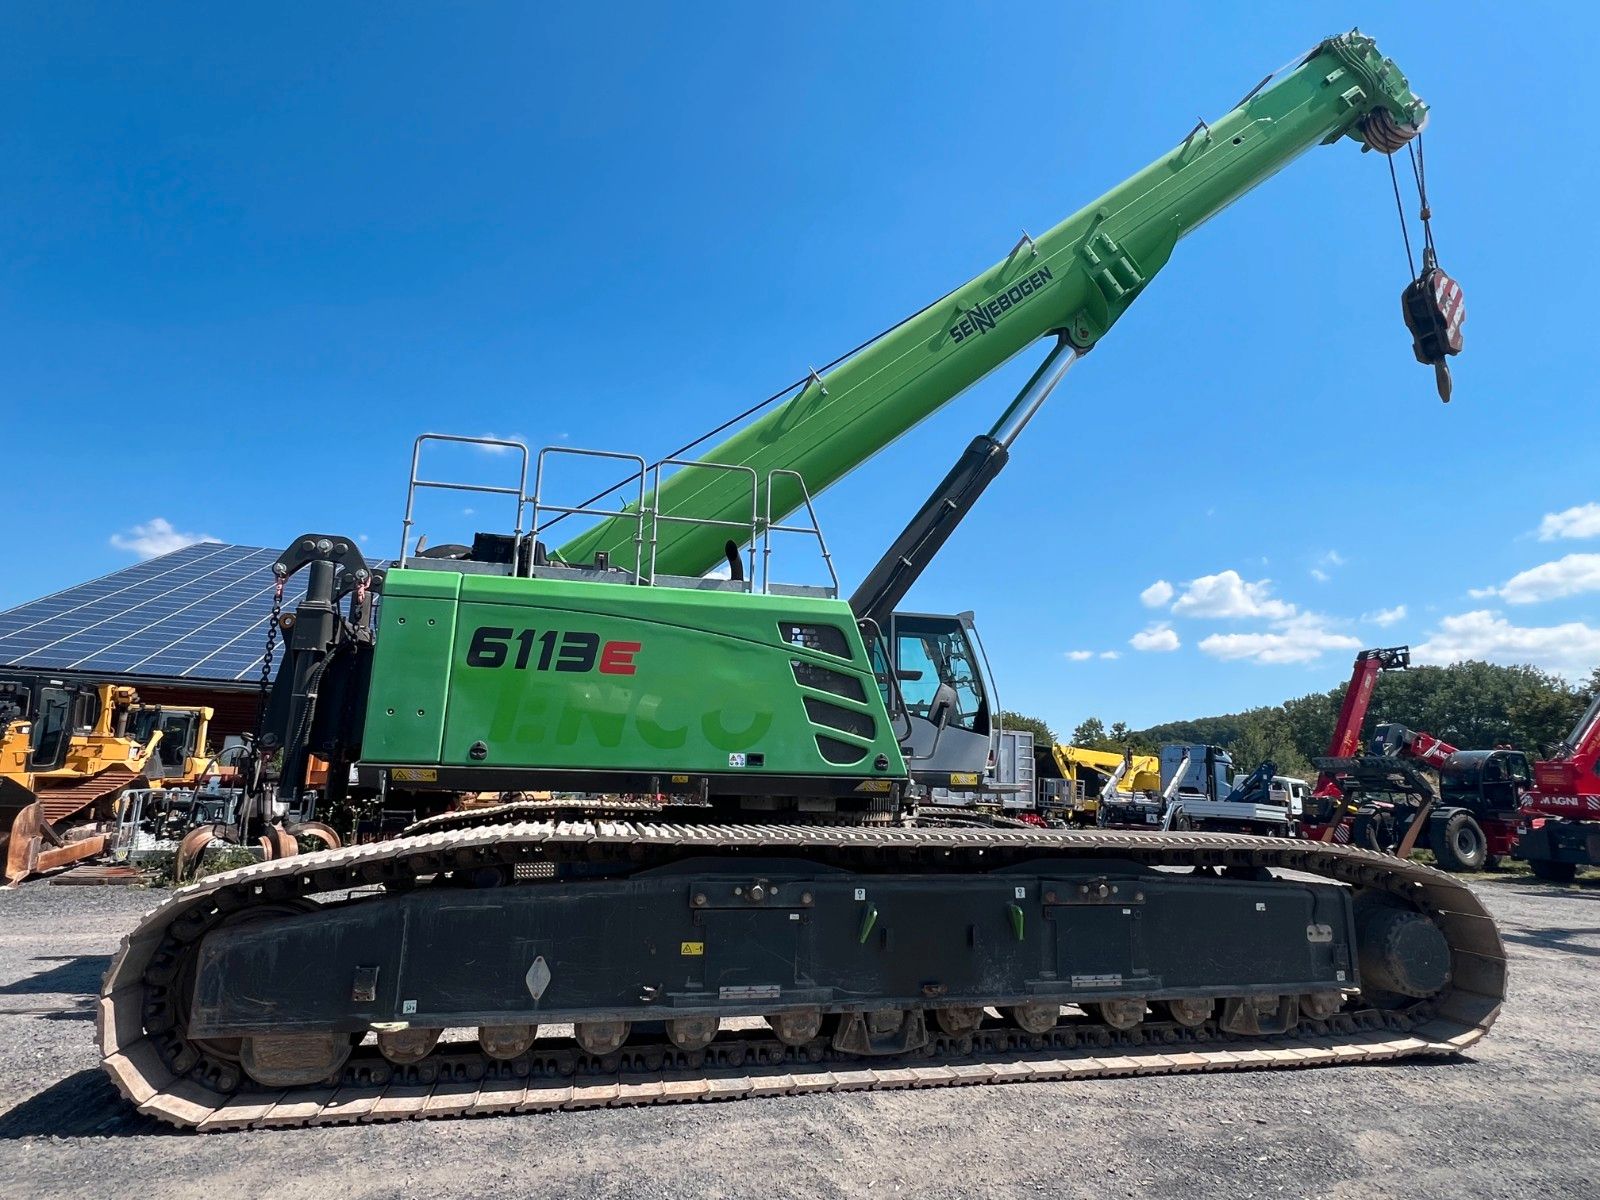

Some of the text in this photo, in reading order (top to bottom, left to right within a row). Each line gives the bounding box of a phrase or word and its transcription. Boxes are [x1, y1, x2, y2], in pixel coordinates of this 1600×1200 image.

[949, 266, 1053, 344] SENNEBOGEN
[466, 627, 642, 675] 6113E
[1540, 796, 1578, 806] MAGNI
